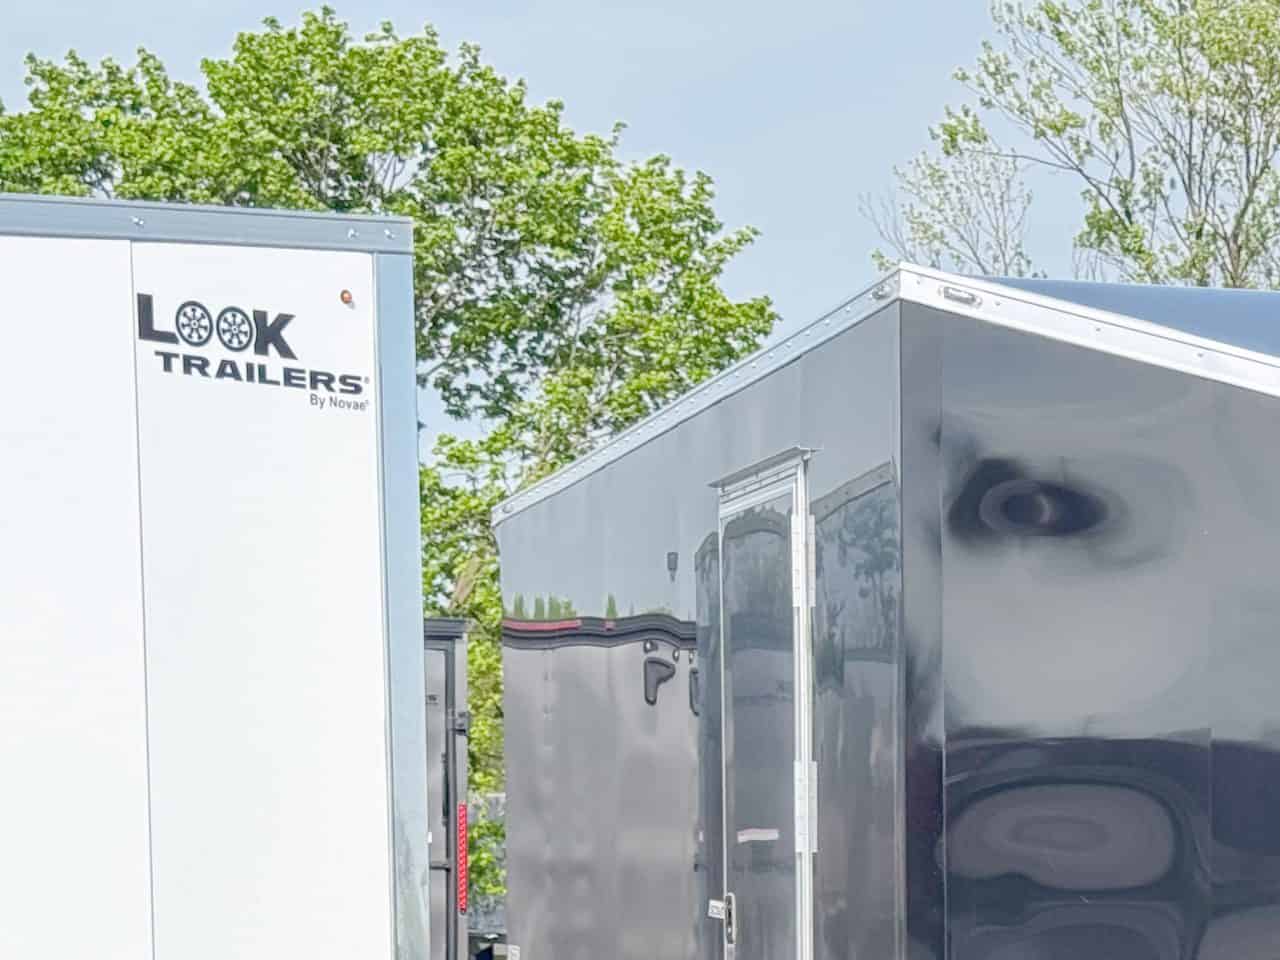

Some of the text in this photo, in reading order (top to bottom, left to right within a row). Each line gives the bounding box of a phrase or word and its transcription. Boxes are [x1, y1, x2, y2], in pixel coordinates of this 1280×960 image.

[137, 293, 298, 360] LOOK
[155, 350, 364, 395] TRAILERS
[309, 394, 327, 409] By
